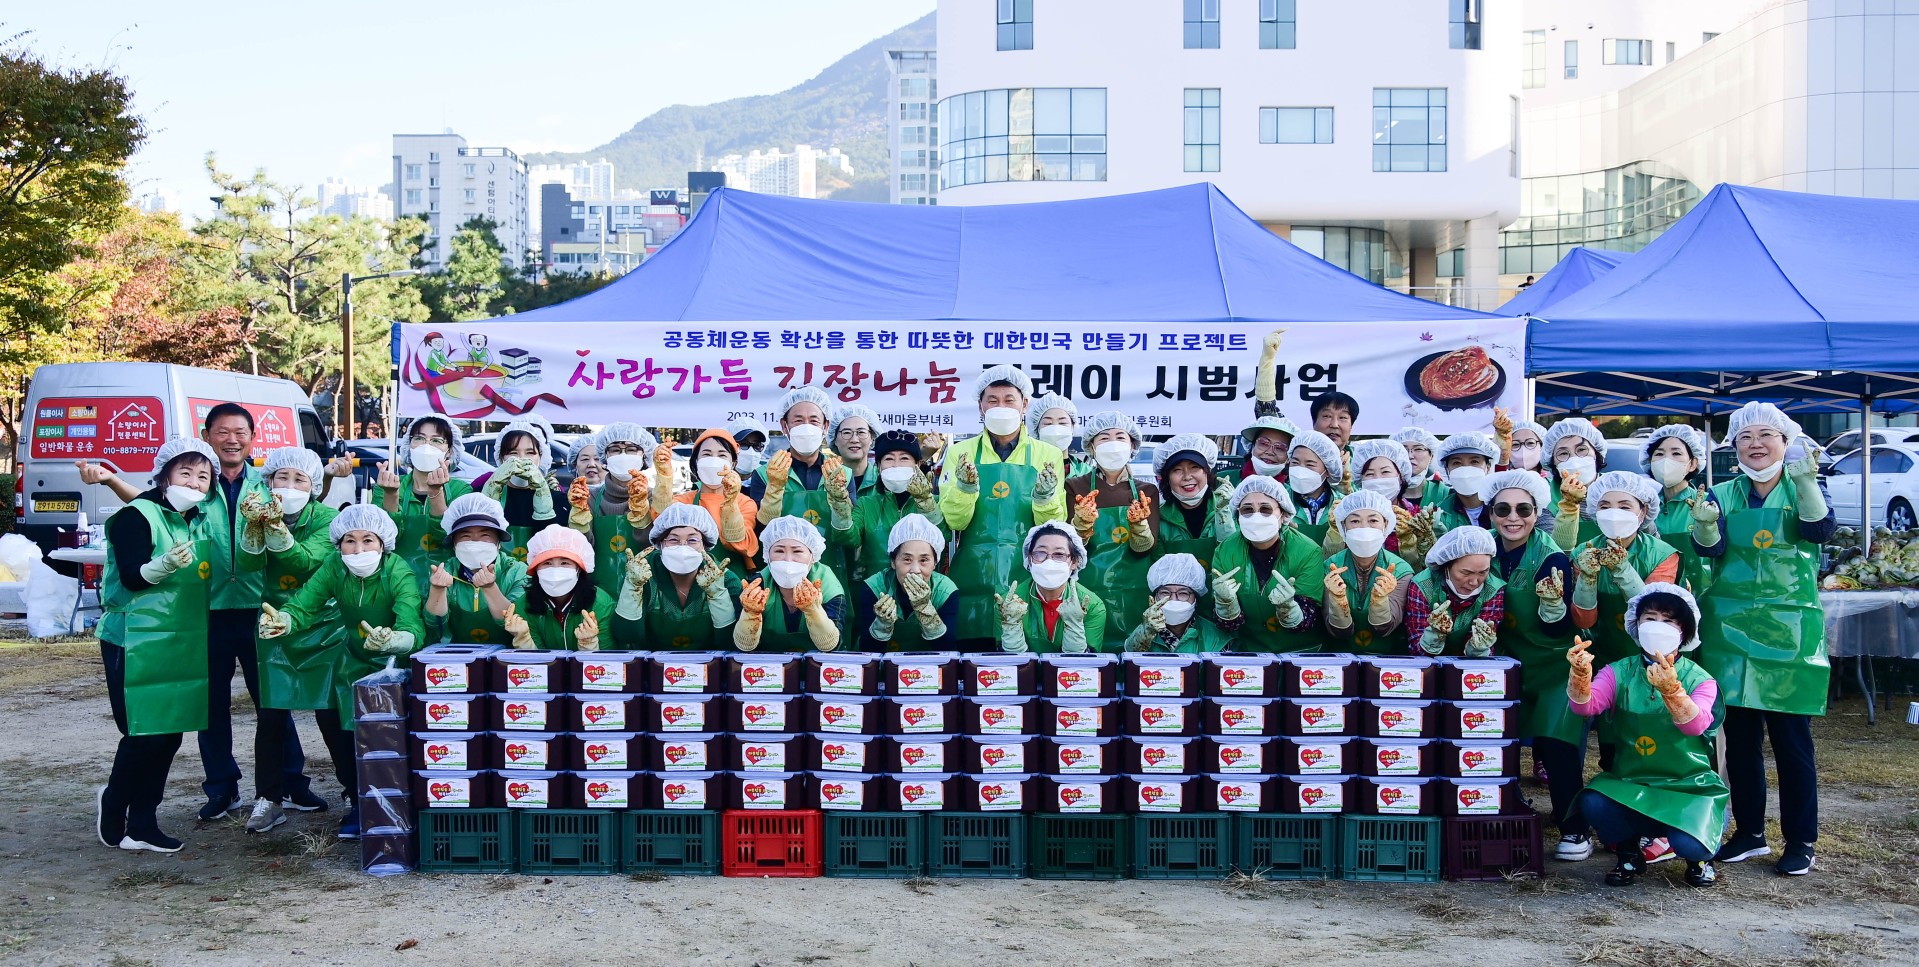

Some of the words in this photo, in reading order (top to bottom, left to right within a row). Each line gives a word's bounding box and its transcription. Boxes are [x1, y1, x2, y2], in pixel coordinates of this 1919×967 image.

[663, 330, 772, 349] 공동체운동
[780, 330, 846, 349] 확산을
[855, 330, 899, 349] 통한
[907, 331, 975, 350] 따뜻한
[984, 331, 1073, 351] 대한민국
[1082, 332, 1148, 351] 만들기
[1158, 333, 1248, 352] 프로젝트
[568, 357, 752, 401] 사랑가득
[982, 363, 1122, 401] 레이
[117, 421, 148, 430] 소량이사
[39, 428, 63, 436] 포장이사
[70, 427, 96, 436] 개인용달
[117, 431, 147, 440] 전문센터
[39, 441, 74, 453] 일반화물
[76, 441, 95, 453] 운송
[56, 502, 76, 511] 5788
